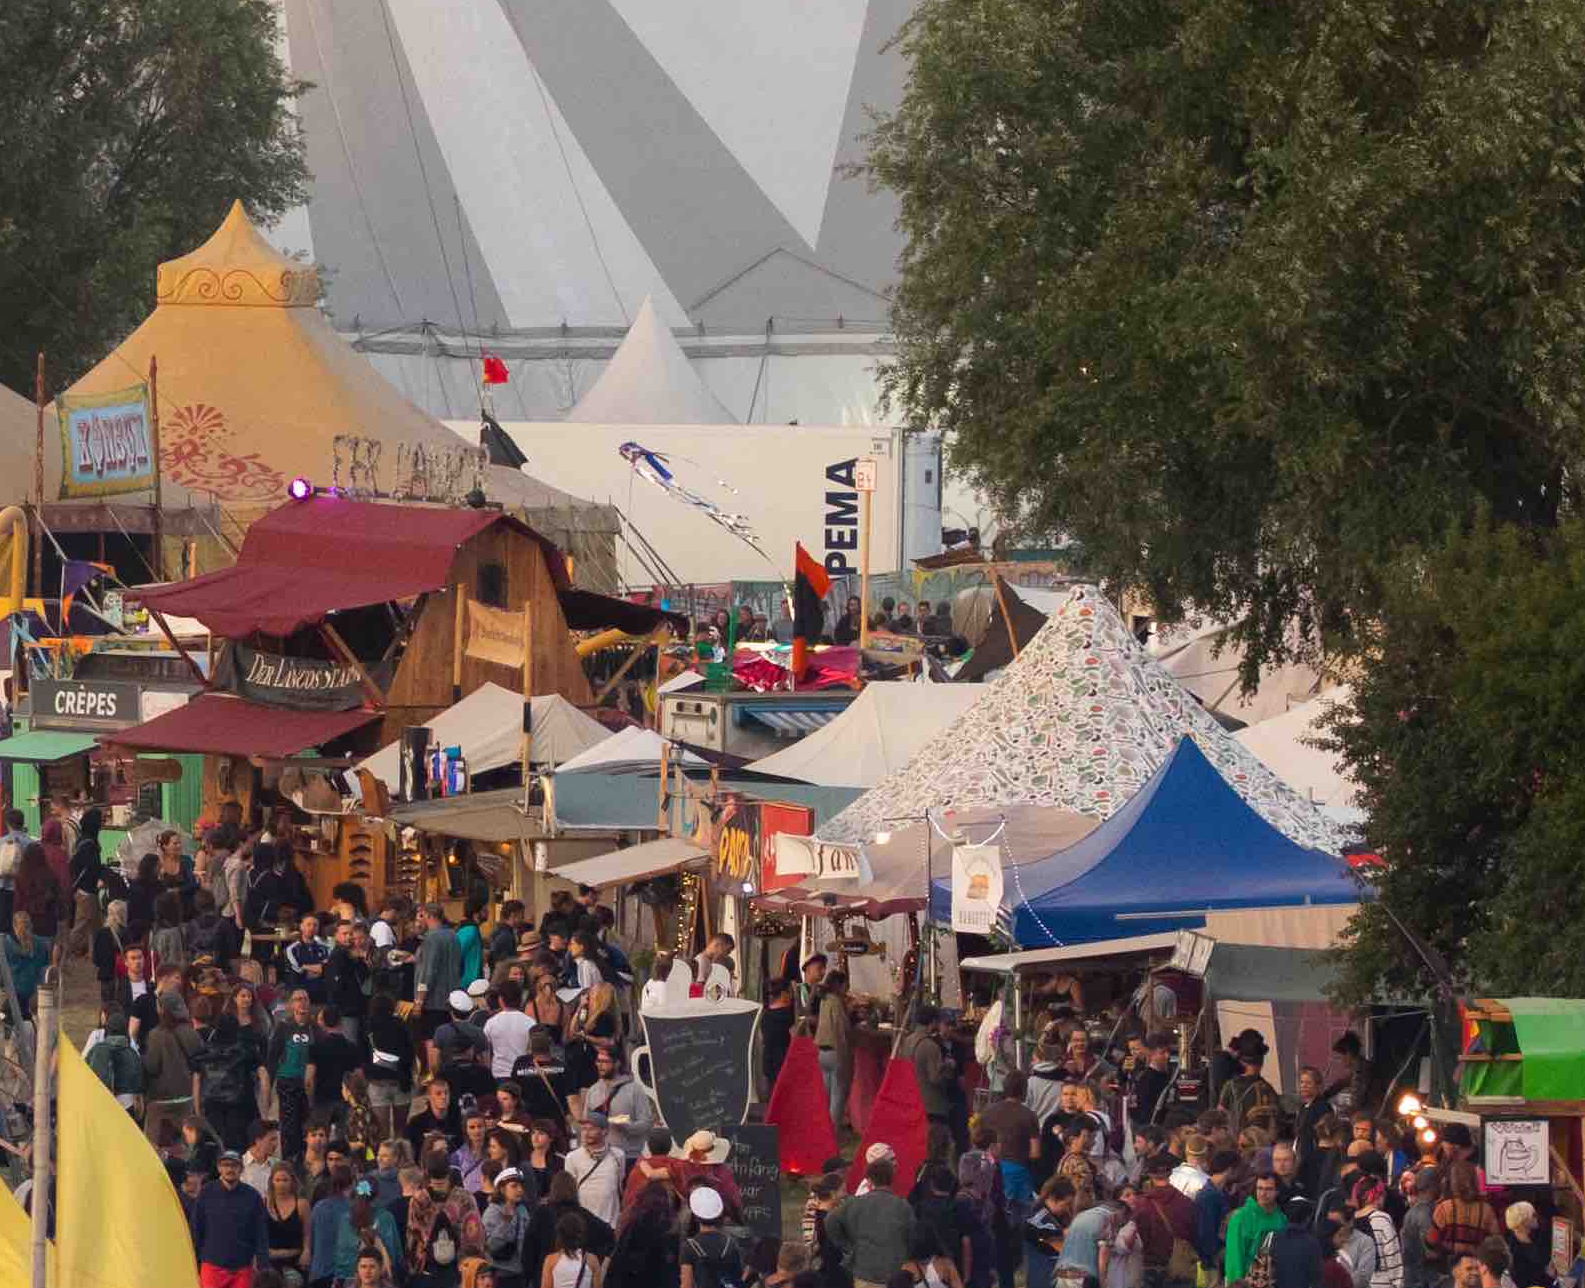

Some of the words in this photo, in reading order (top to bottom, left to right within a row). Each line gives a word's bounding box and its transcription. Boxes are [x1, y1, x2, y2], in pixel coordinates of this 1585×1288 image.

[825, 457, 859, 575] PEMA
[246, 654, 275, 686] DER
[55, 684, 117, 716] CRÊPES
